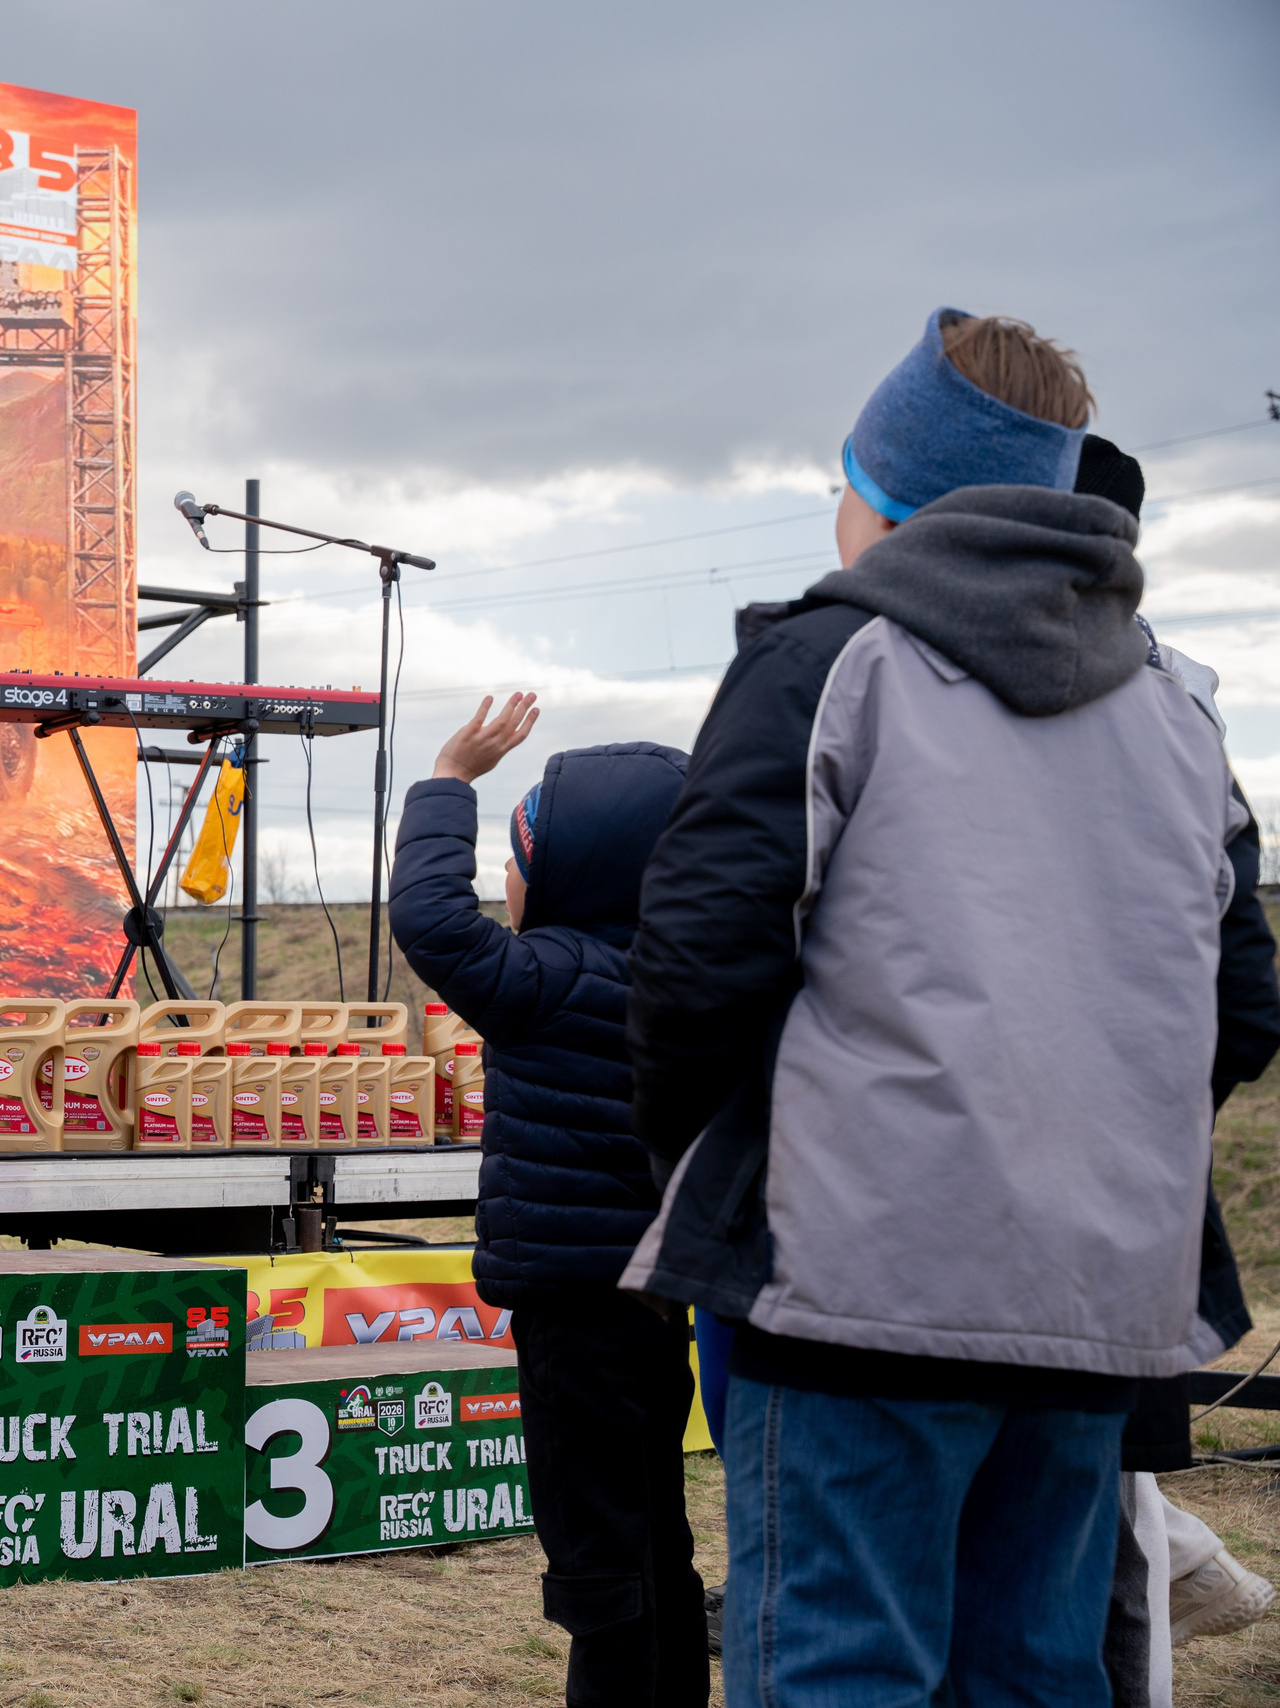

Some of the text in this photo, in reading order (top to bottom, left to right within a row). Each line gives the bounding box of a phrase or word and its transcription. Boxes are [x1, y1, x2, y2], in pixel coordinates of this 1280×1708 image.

[4, 687, 55, 707] stage
[55, 688, 68, 705] 4
[186, 1306, 229, 1328] 85
[87, 1332, 165, 1346] УРАЛ
[33, 1347, 63, 1358] RUSSIA
[186, 1349, 228, 1357] УРАЛ
[352, 1405, 375, 1418] URAL
[380, 1405, 402, 1416] 2026
[427, 1416, 450, 1424] RUSSIA
[103, 1406, 219, 1457] TRIAL
[387, 1418, 395, 1427] 10
[374, 1441, 453, 1476] TRUCK
[245, 1398, 332, 1550] 3
[443, 1482, 534, 1533] URAL
[60, 1482, 218, 1560] URAL
[380, 1518, 433, 1541] RUSSIA
